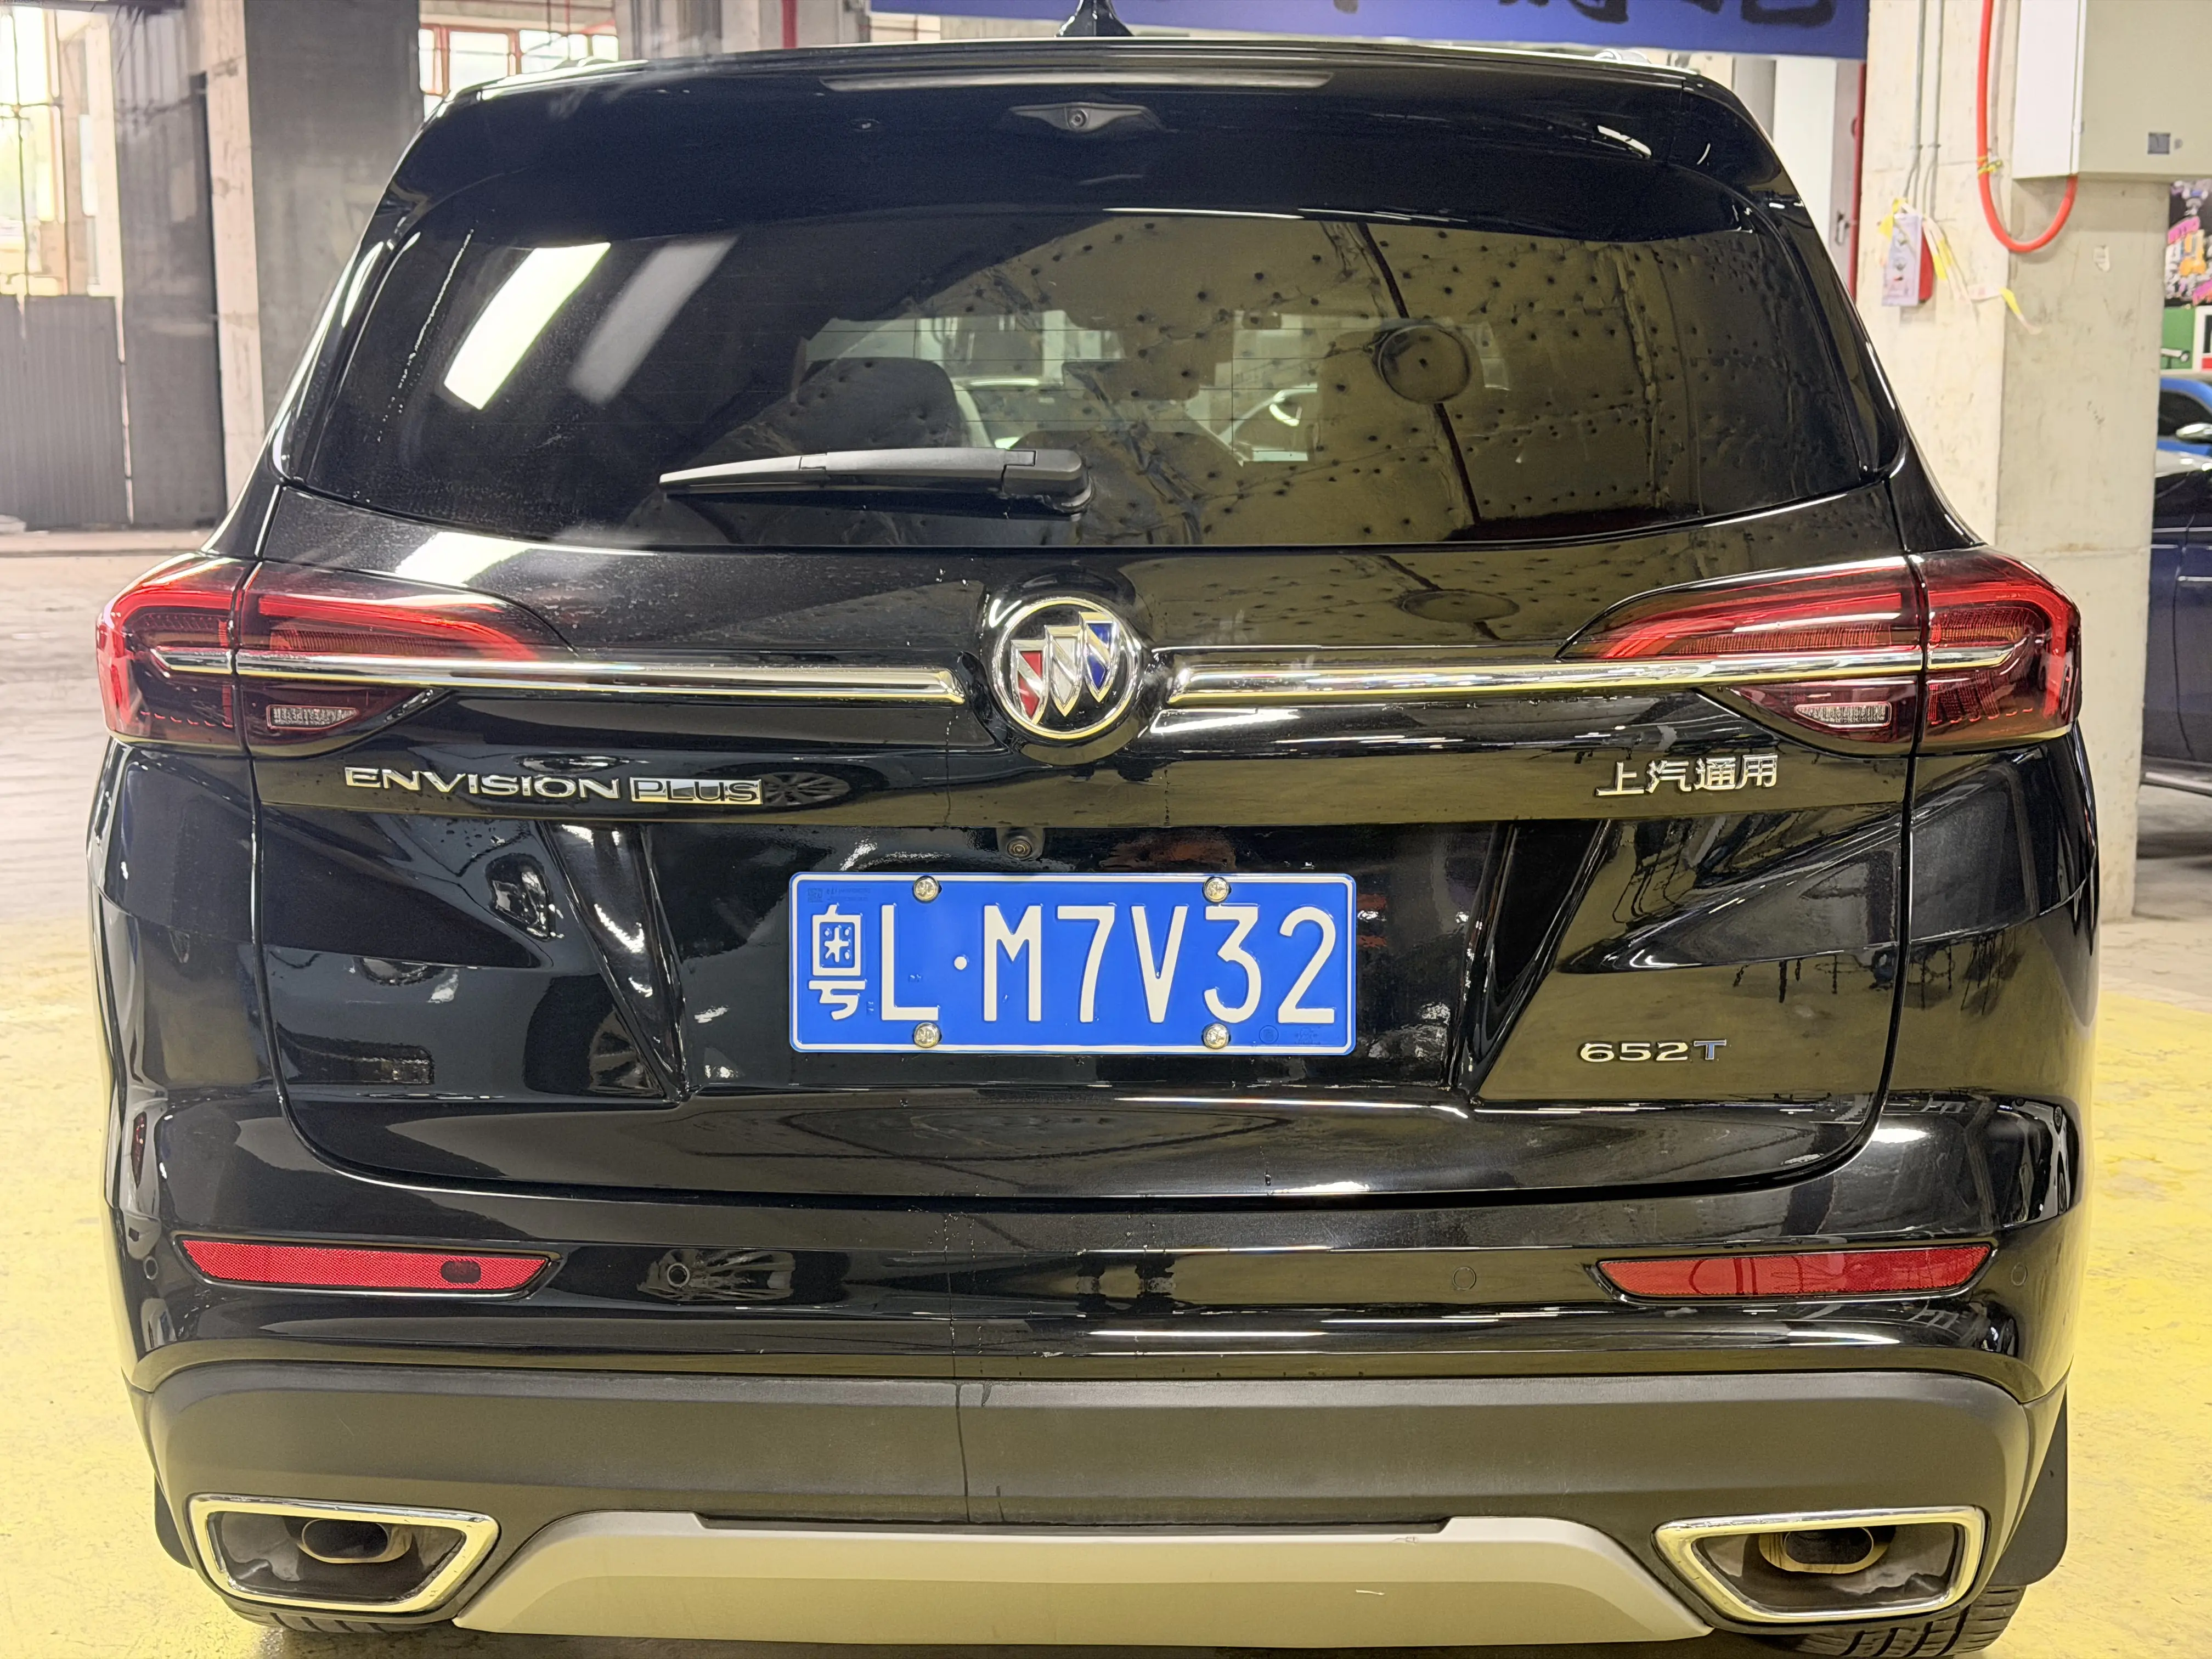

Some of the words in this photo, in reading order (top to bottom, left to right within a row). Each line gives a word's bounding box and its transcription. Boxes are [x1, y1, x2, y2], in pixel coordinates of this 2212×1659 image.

[345, 766, 620, 799] ENVISION
[631, 777, 761, 804] PLUS
[1595, 753, 1778, 796] 上汽通用
[1579, 1039, 1727, 1062] 652T
